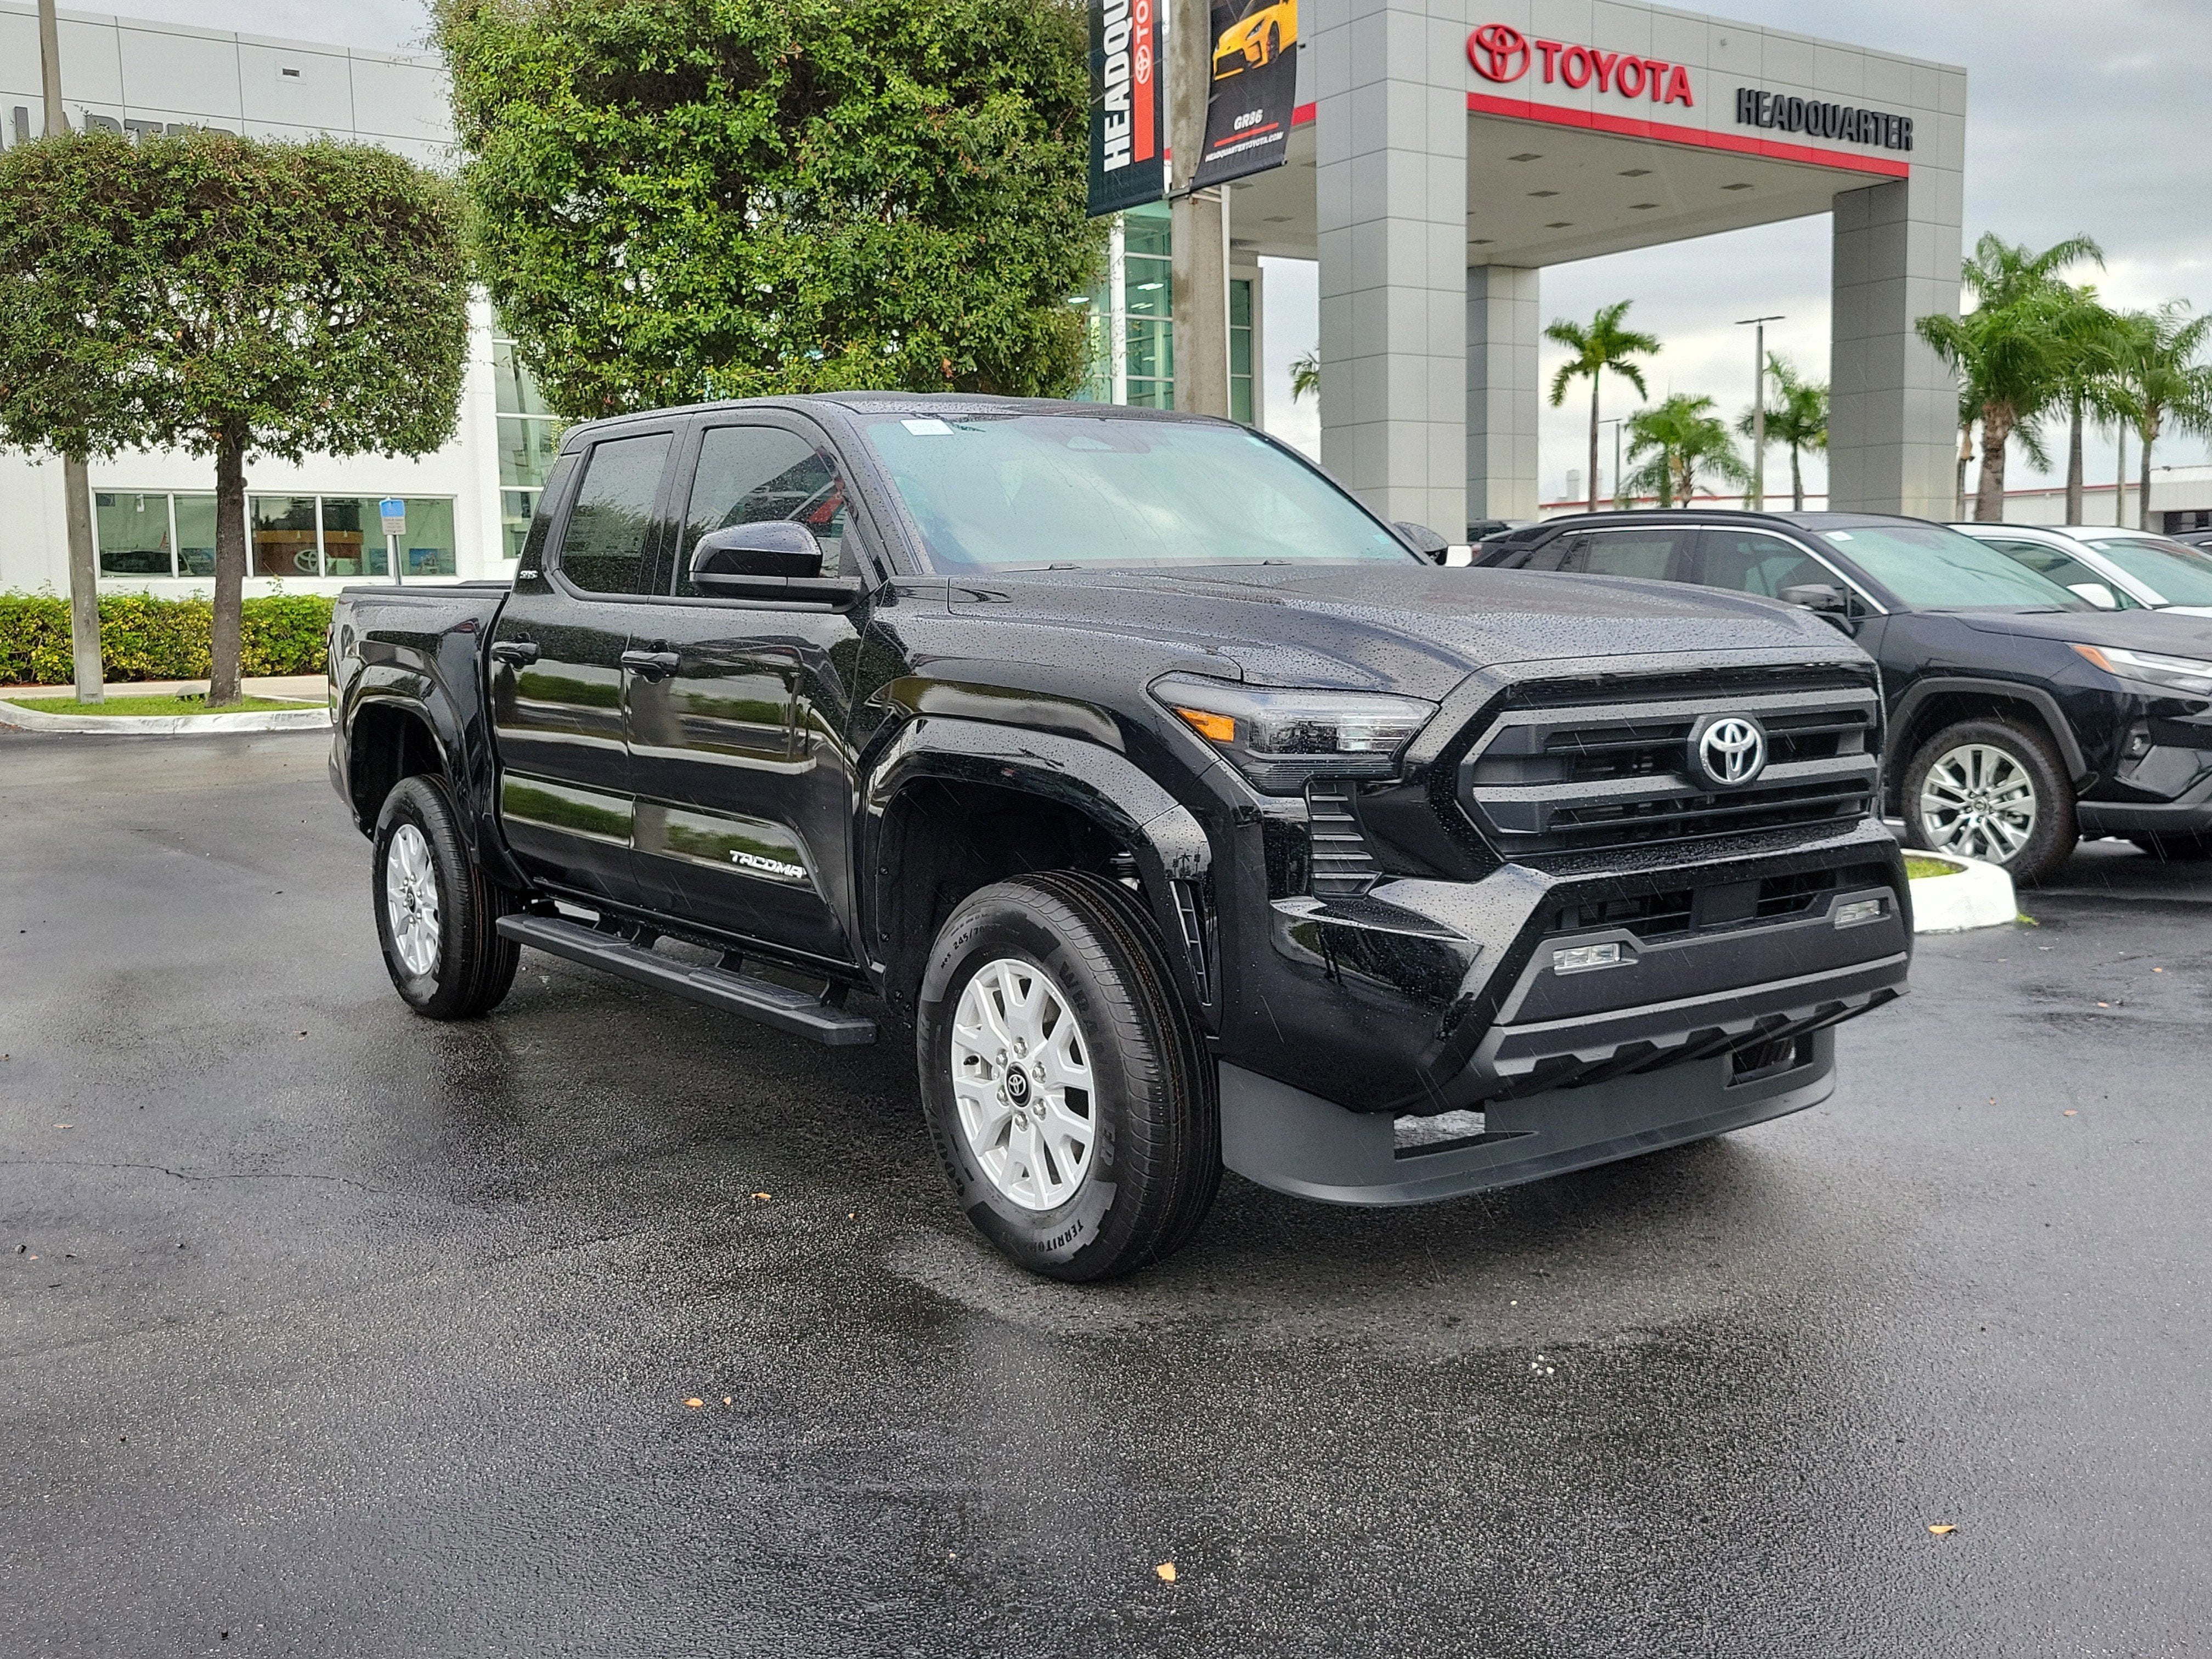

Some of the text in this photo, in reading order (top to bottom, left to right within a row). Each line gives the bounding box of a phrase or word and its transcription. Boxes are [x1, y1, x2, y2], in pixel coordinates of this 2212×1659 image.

[1136, 0, 1149, 44] TO
[1536, 40, 1914, 151] TOYOTA HEADQUARTER
[729, 849, 807, 878] TACOMA
[1059, 960, 1116, 1166] WRANLER
[918, 1013, 966, 1198] GOODAR
[1028, 1218, 1084, 1252] TERRITO
